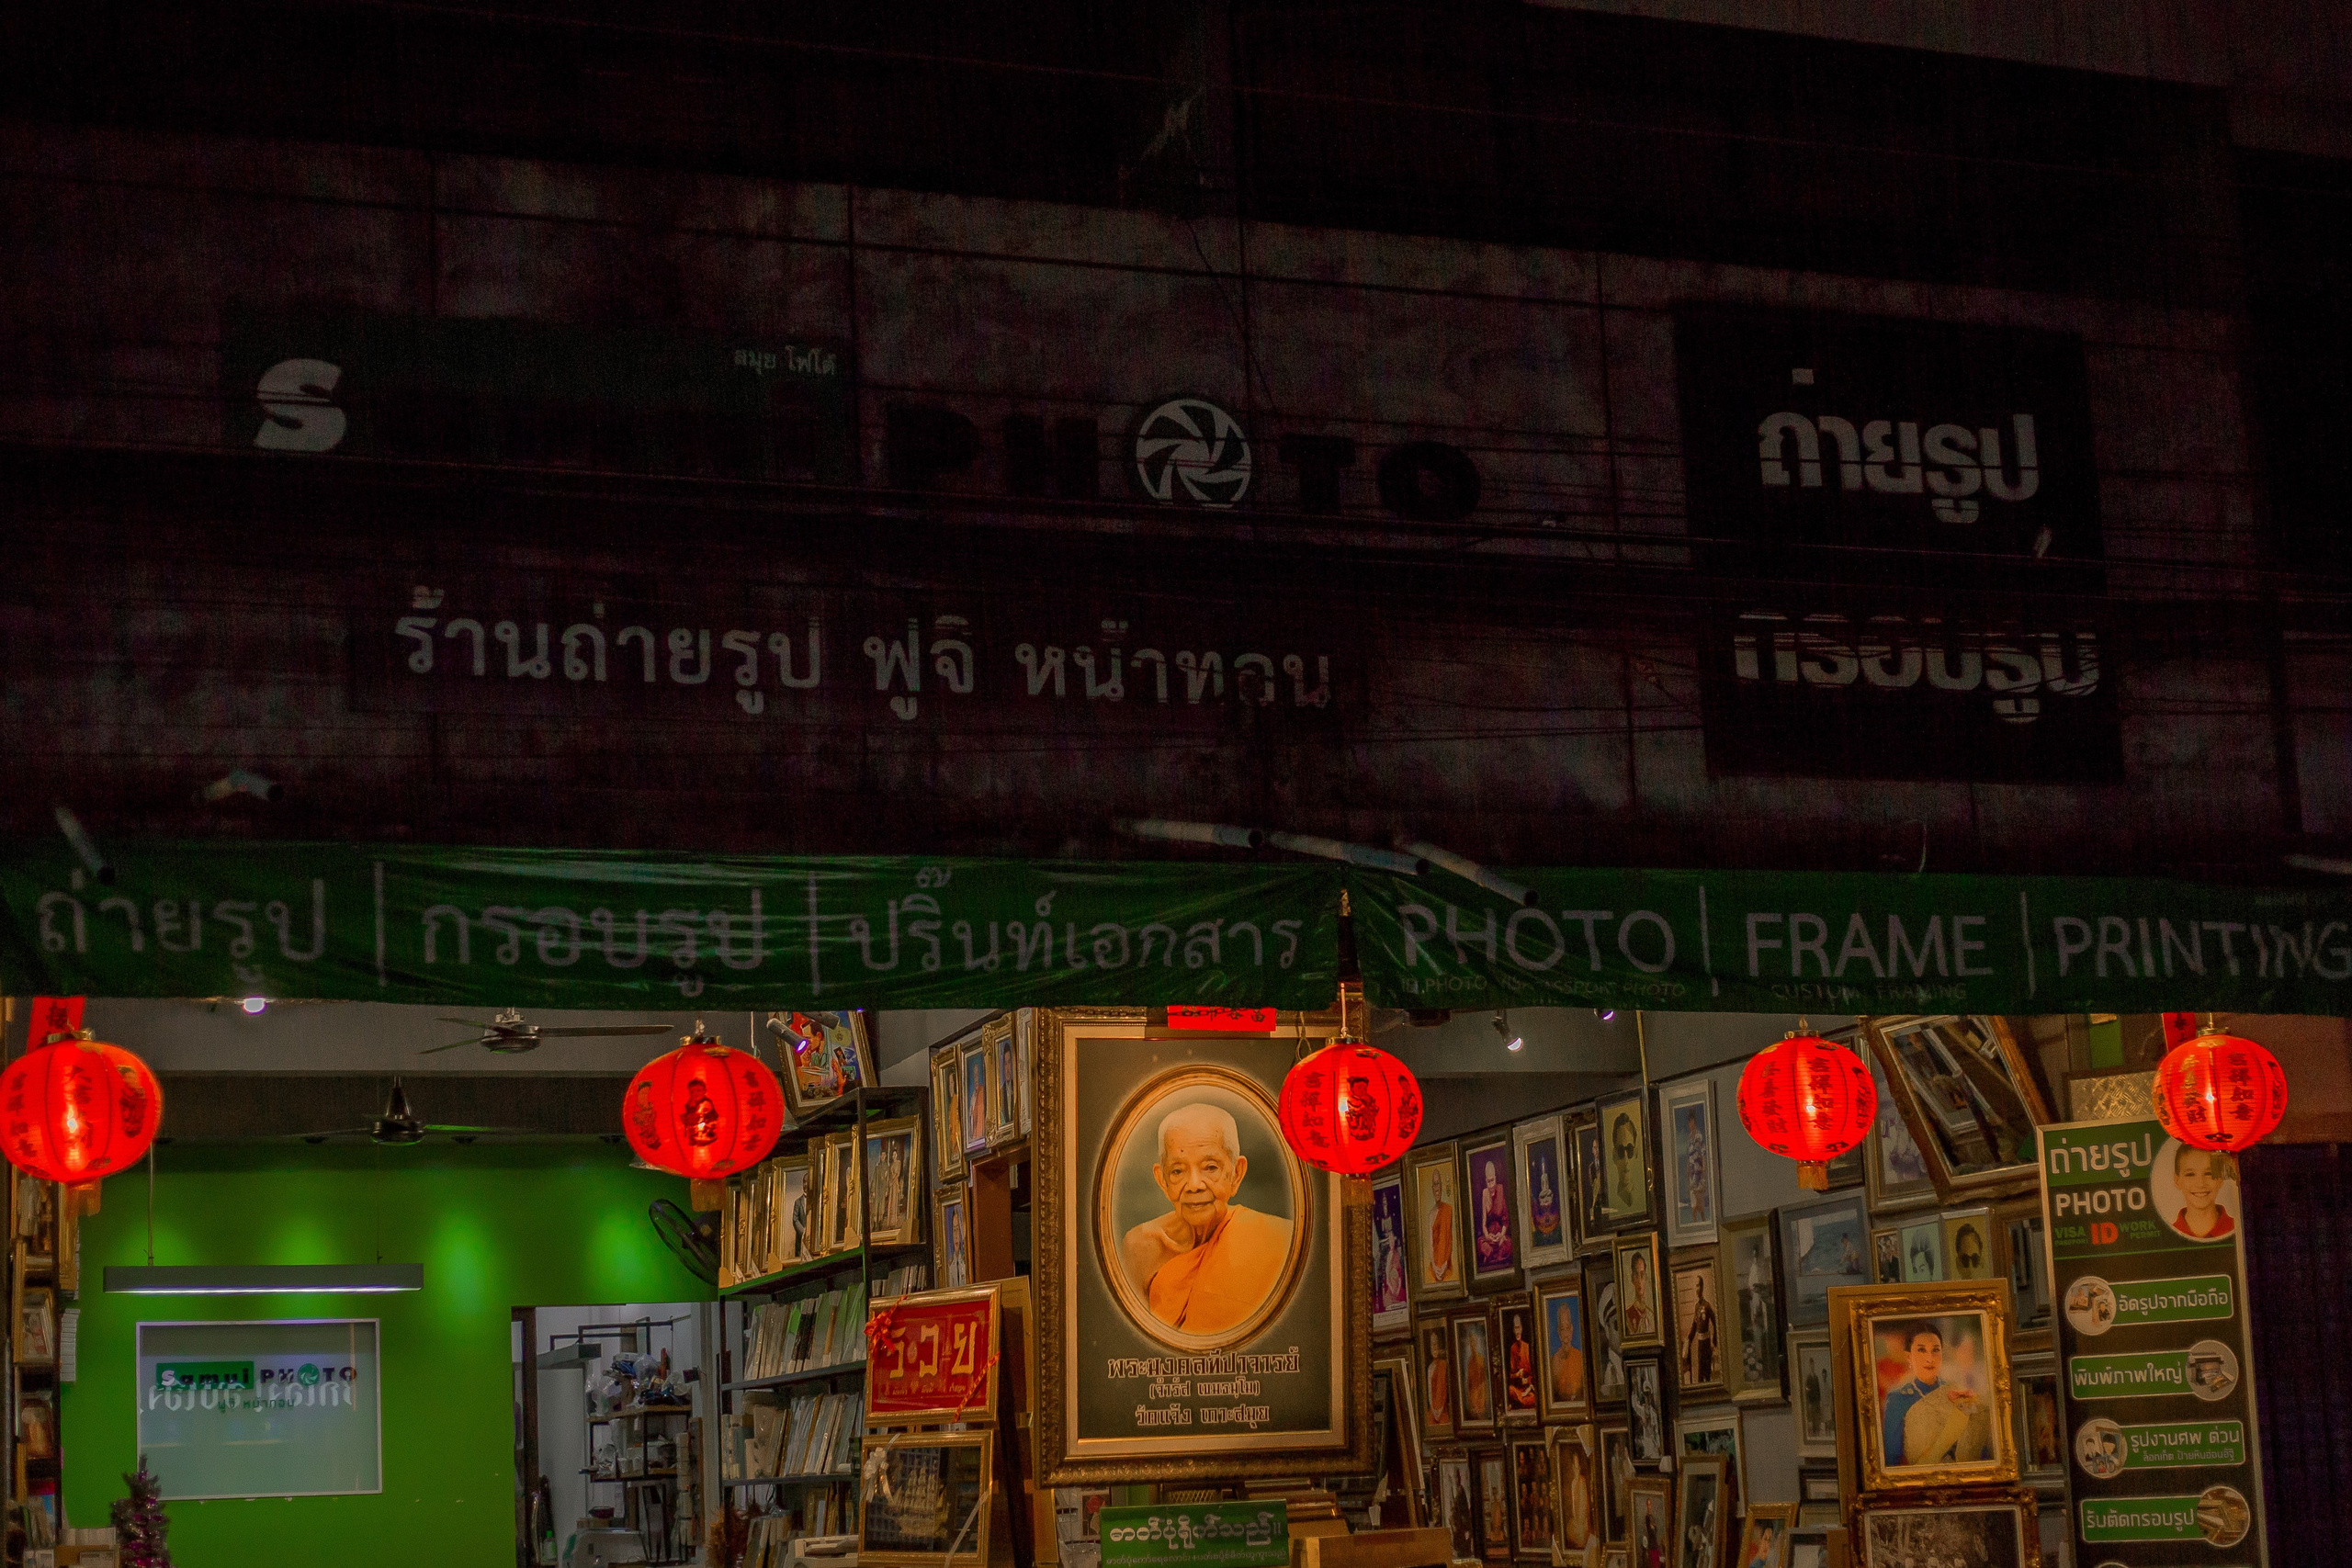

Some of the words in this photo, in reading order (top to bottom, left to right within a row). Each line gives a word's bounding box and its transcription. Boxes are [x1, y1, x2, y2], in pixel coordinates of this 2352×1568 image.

[1758, 367, 2040, 525] ถ่ายรูป
[394, 584, 823, 715] ร้านถ่ายรูป
[862, 614, 976, 721] ฟูจิ
[1013, 619, 1332, 710] หน้าทอน
[34, 867, 326, 987] ถ่ายรูป
[421, 886, 766, 998] กรอบรูป
[1396, 903, 1677, 974] PHOTO
[1745, 912, 1995, 978] FRAME
[2052, 916, 2352, 981] PRINTING
[2050, 1133, 2153, 1178] ถ่ายรูป
[2055, 1187, 2146, 1217] PHOTO
[2053, 1225, 2086, 1239] VISA
[2090, 1222, 2120, 1246] ID
[2119, 1219, 2157, 1233] WORK
[2130, 1229, 2161, 1240] PERMIT
[2118, 1287, 2229, 1316] อัดรูปจากมือถือ
[161, 1367, 250, 1387] Samui
[2074, 1360, 2183, 1387] พิมพ์ภาพใหญ่
[2130, 1430, 2202, 1454] รูปงานศพ
[2208, 1425, 2240, 1444] ด่วน
[2086, 1508, 2196, 1532] รับตัดกรอบรูป
